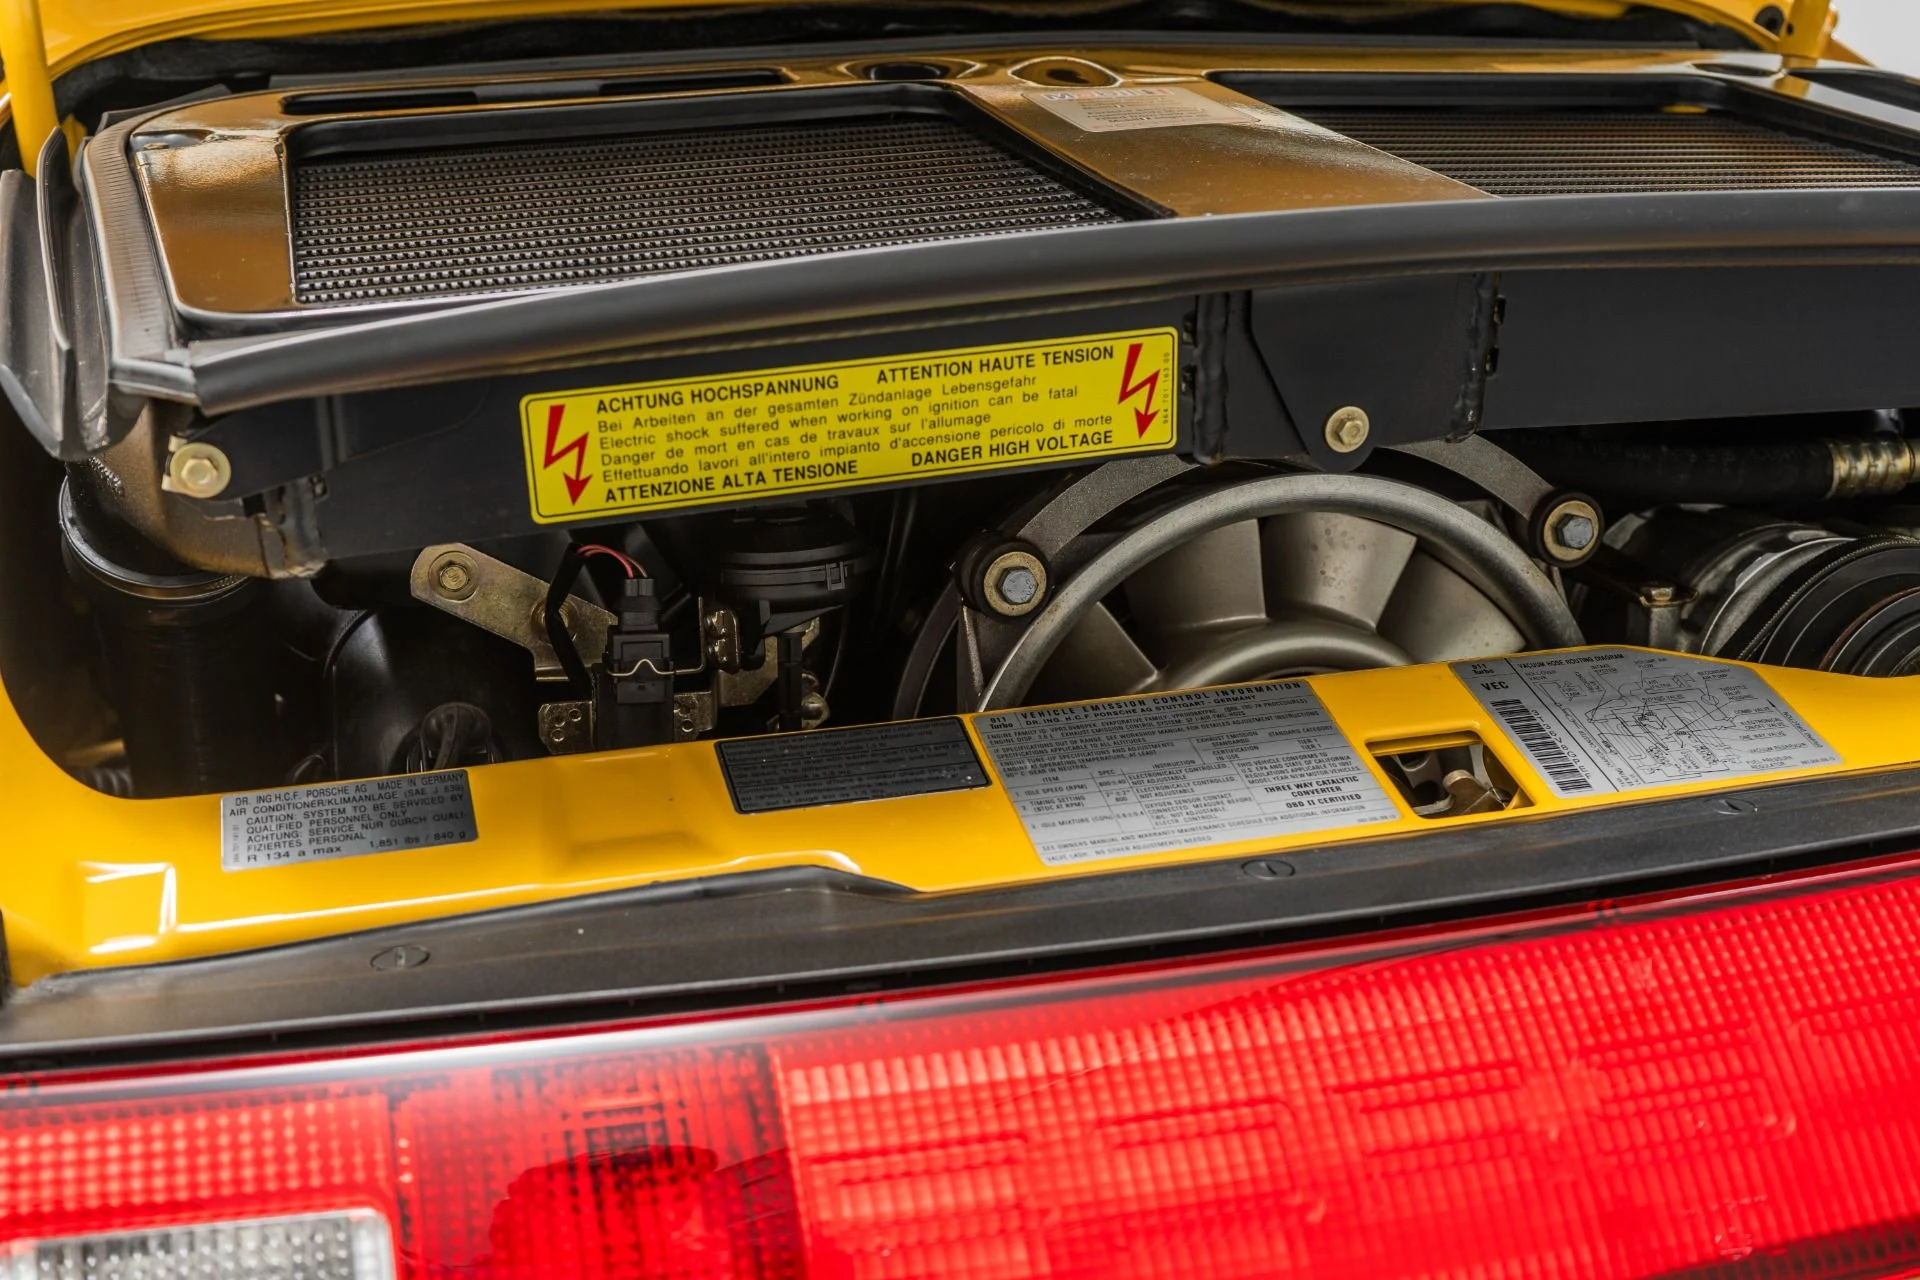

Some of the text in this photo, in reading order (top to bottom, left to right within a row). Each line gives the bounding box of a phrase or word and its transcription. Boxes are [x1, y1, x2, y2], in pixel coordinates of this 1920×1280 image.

[876, 344, 1113, 384] ATTENTION HAUTE TENSION
[595, 373, 838, 414] ACHTUNG HOCHSPANNUNG
[597, 373, 1036, 434] Bei Arbeiten an der gesamten Zündanlage Lebensgefahr
[599, 385, 1077, 450] Electric shock suffered when working on ignition can be fatal
[600, 411, 991, 468] Danger de mort en cas de travaux sur l'allumage
[602, 414, 1112, 483] Effettuando lavori all'intero impianto d'accensione pericolo di morte
[911, 429, 1112, 466] DANGER HIGH VOLTAGE
[604, 459, 858, 502] ATTENZIONE ALTA TENSIONE
[1563, 656, 1594, 664] ROUTING
[1592, 653, 1625, 661] DIAGRAM
[1480, 680, 1510, 690] VEC
[1021, 682, 1301, 719] VEHICLE EMISSION CONTROL INFORMATION
[1094, 708, 1137, 717] PORSCHE
[1154, 700, 1206, 710] STUTTGART
[1213, 694, 1256, 703] GERMANY
[989, 721, 1013, 729] Turbo
[1253, 757, 1280, 765] VEHICLE
[1281, 753, 1318, 762] CONFORMS
[1314, 755, 1350, 764] CALIFORNIA
[1128, 768, 1183, 779] ELECTRONICALLY
[1146, 774, 1187, 783] ADJUSTABLE
[1244, 768, 1289, 778] REGULATIONS
[1290, 764, 1327, 772] APPLICABLE
[235, 796, 251, 806] DR.
[305, 785, 348, 798] PORSCHE
[354, 783, 367, 793] AG
[376, 780, 402, 791] MADE
[407, 778, 416, 787] IN
[421, 773, 464, 786] GERMANY
[1135, 782, 1190, 793] ELECTRONICALLY
[1153, 787, 1194, 797] ADJUSTABLE
[1264, 776, 1358, 792] THREE WAY CATALYTIC
[1291, 785, 1342, 797] CONVERTER
[229, 807, 246, 816] AIR
[432, 786, 438, 794] J
[303, 806, 346, 819] SYSTEM
[353, 804, 366, 813] TO
[372, 802, 386, 811] BE
[392, 795, 445, 809] SERVICED
[449, 793, 465, 802] BY
[1286, 800, 1304, 808] OBD
[1317, 793, 1362, 804] CERTIFIED
[246, 808, 408, 835] QUALIFIED PERSONNEL ONLY
[308, 823, 353, 836] SERVICE
[360, 820, 384, 830] NUR
[389, 815, 426, 826] DURCH
[246, 831, 366, 853] FIZIERTES PERSONAL
[247, 854, 256, 863] R
[266, 850, 289, 860] 134
[297, 848, 305, 857] a
[312, 844, 341, 855] max
[404, 834, 420, 843] lbs
[433, 830, 454, 840] 840
[458, 830, 466, 839] g
